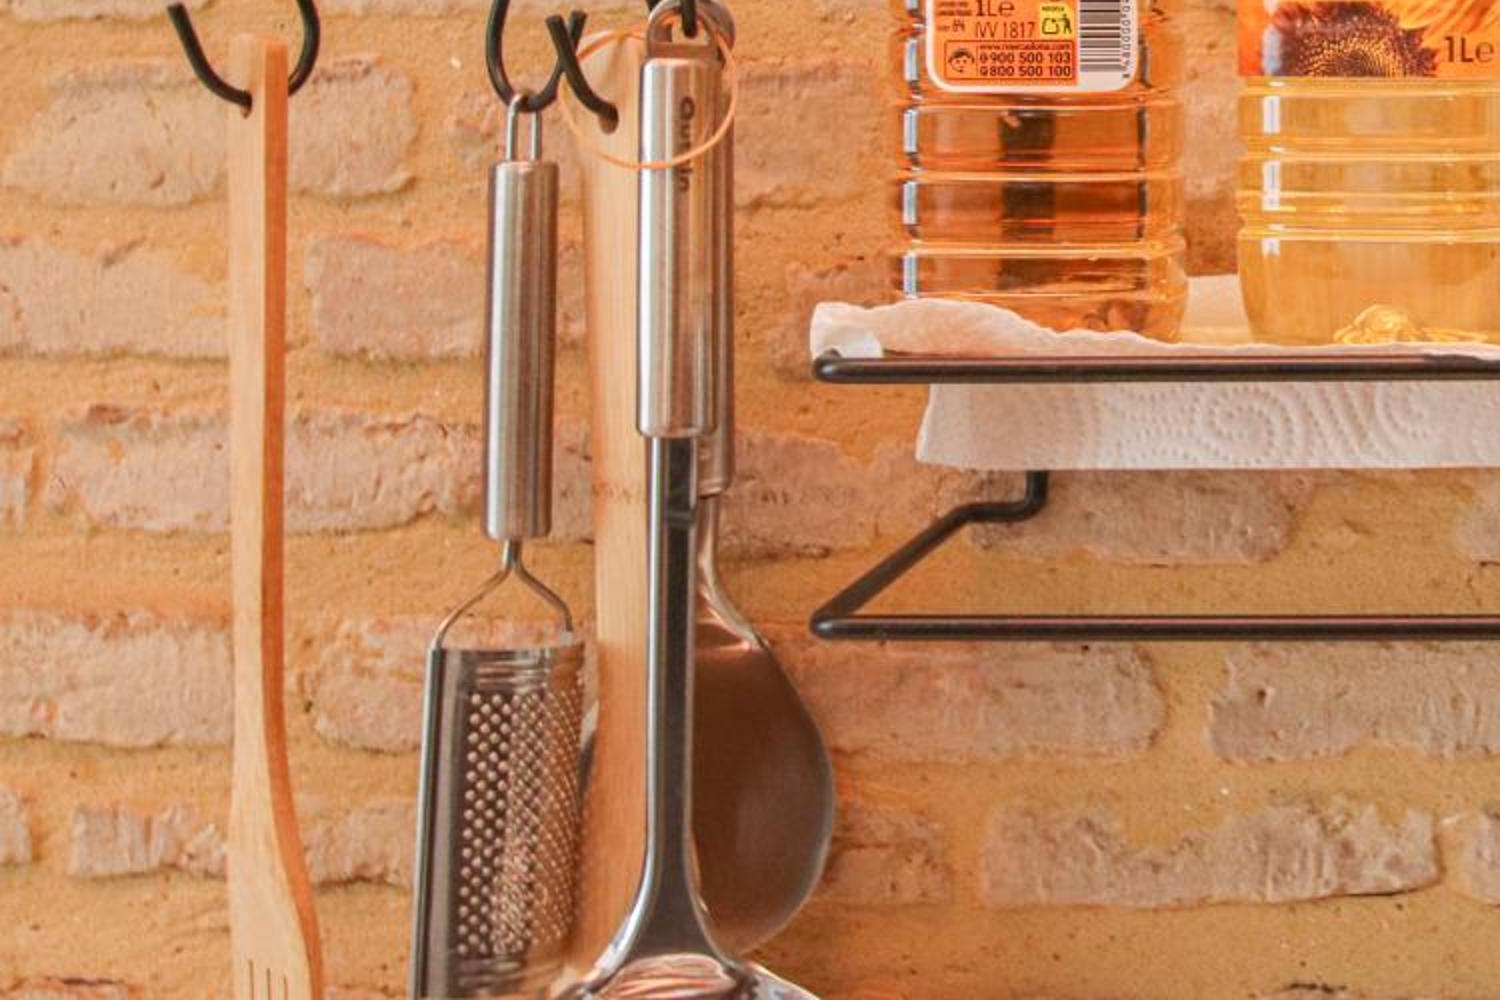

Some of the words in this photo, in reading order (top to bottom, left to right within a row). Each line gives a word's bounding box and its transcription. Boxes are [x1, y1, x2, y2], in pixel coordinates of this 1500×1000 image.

[1003, 21, 1036, 39] 1817
[990, 52, 1015, 64] 900
[1019, 52, 1044, 64] 500
[1048, 52, 1071, 64] 103
[1019, 65, 1044, 77] 500
[1048, 65, 1071, 77] 100
